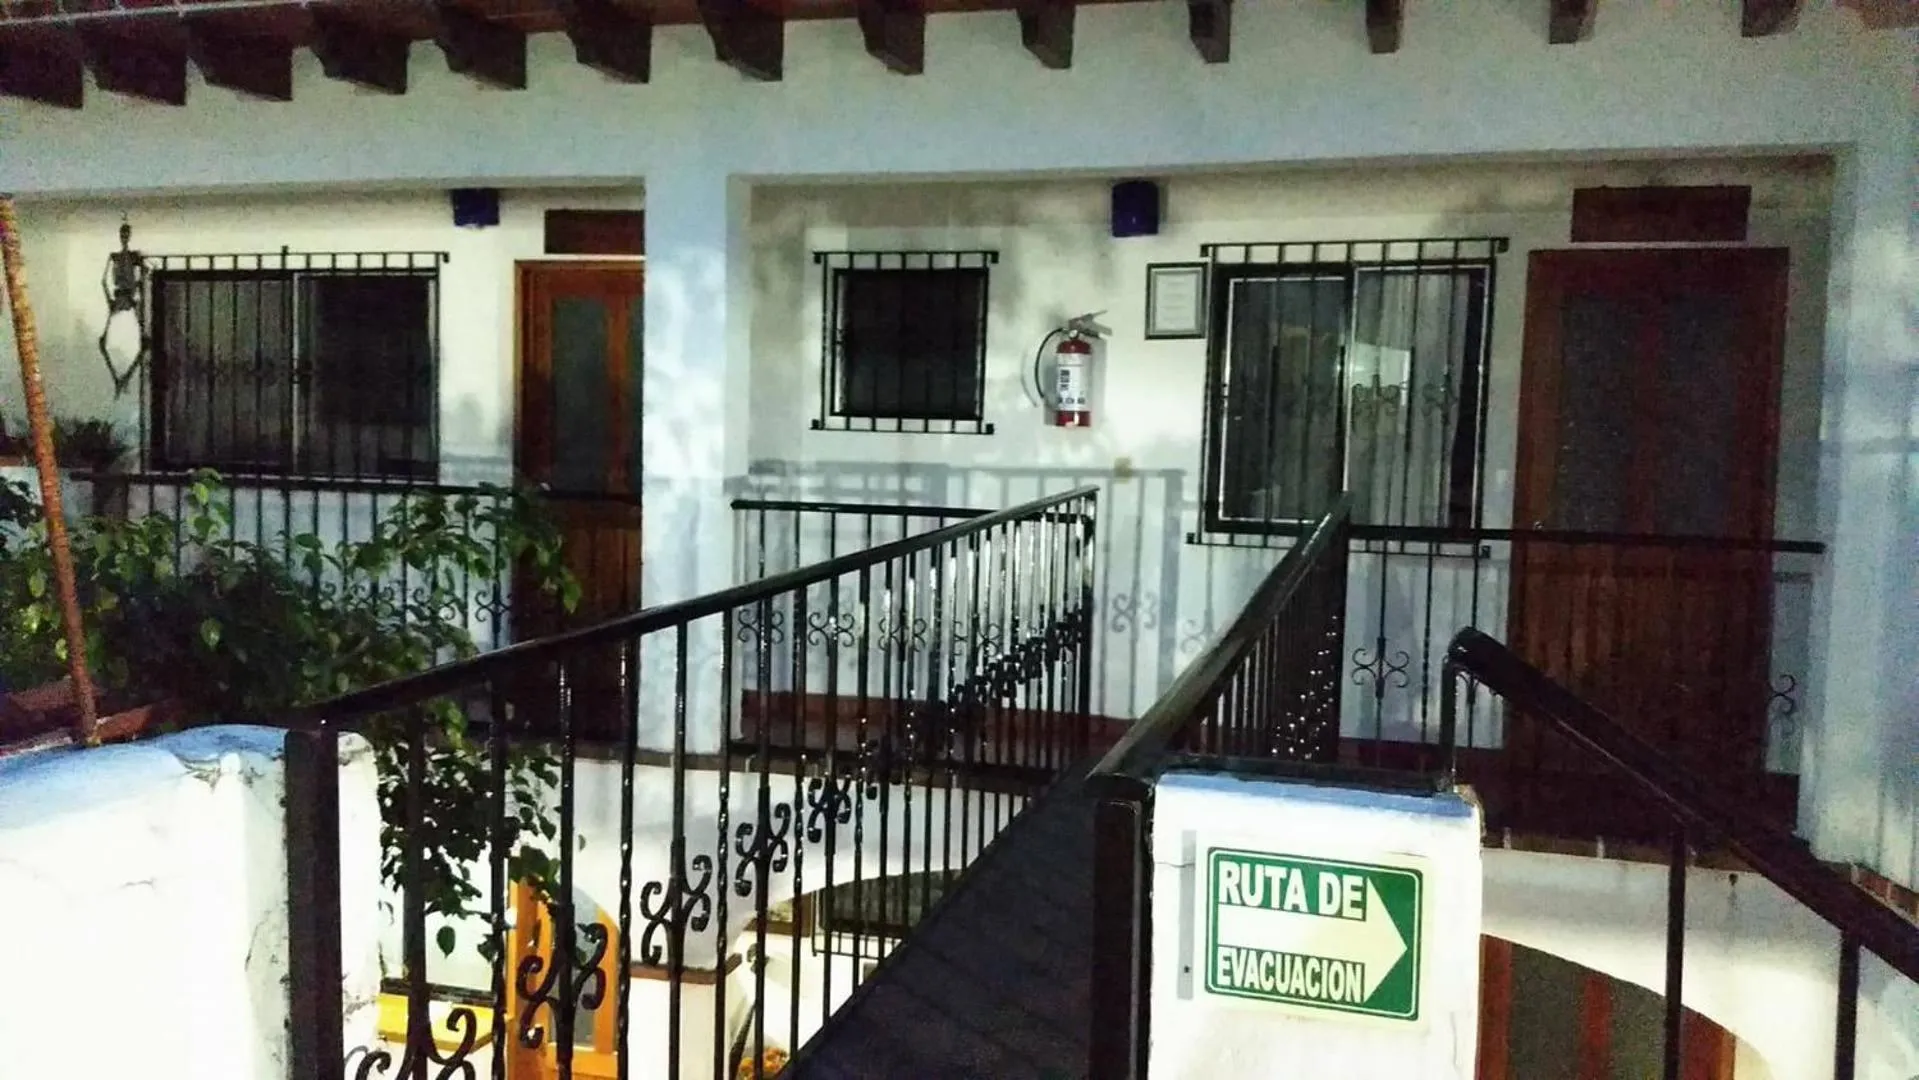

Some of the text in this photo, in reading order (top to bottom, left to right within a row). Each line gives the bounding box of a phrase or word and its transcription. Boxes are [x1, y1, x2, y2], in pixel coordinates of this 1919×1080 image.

[1219, 860, 1363, 919] RUTA DE
[1217, 947, 1362, 1003] EVACUACION
